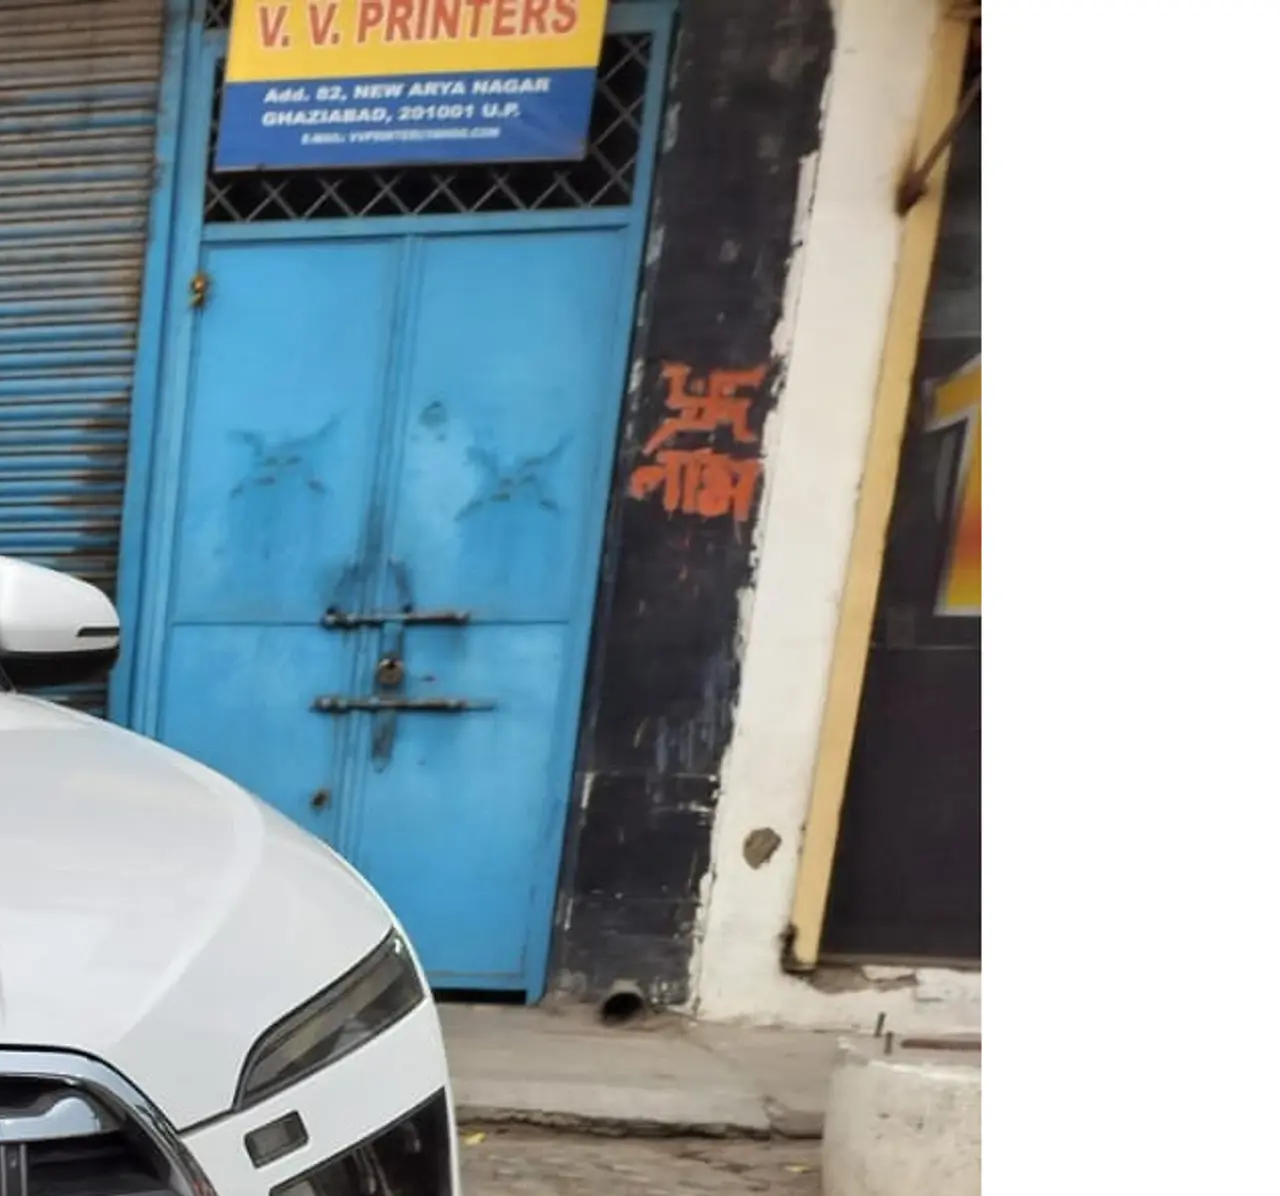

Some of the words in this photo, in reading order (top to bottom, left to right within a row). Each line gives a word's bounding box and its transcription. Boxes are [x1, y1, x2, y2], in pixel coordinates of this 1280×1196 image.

[258, 4, 290, 48] V.
[308, 2, 340, 46] V.
[356, 0, 578, 44] PRINTERS
[263, 86, 311, 104] Add.
[352, 82, 405, 101] NEW
[407, 79, 467, 98] ARYA
[471, 76, 552, 96] NAGAR
[261, 106, 393, 127] GHAZIABAD,
[397, 103, 476, 122] 201001
[481, 101, 522, 119] U.P.
